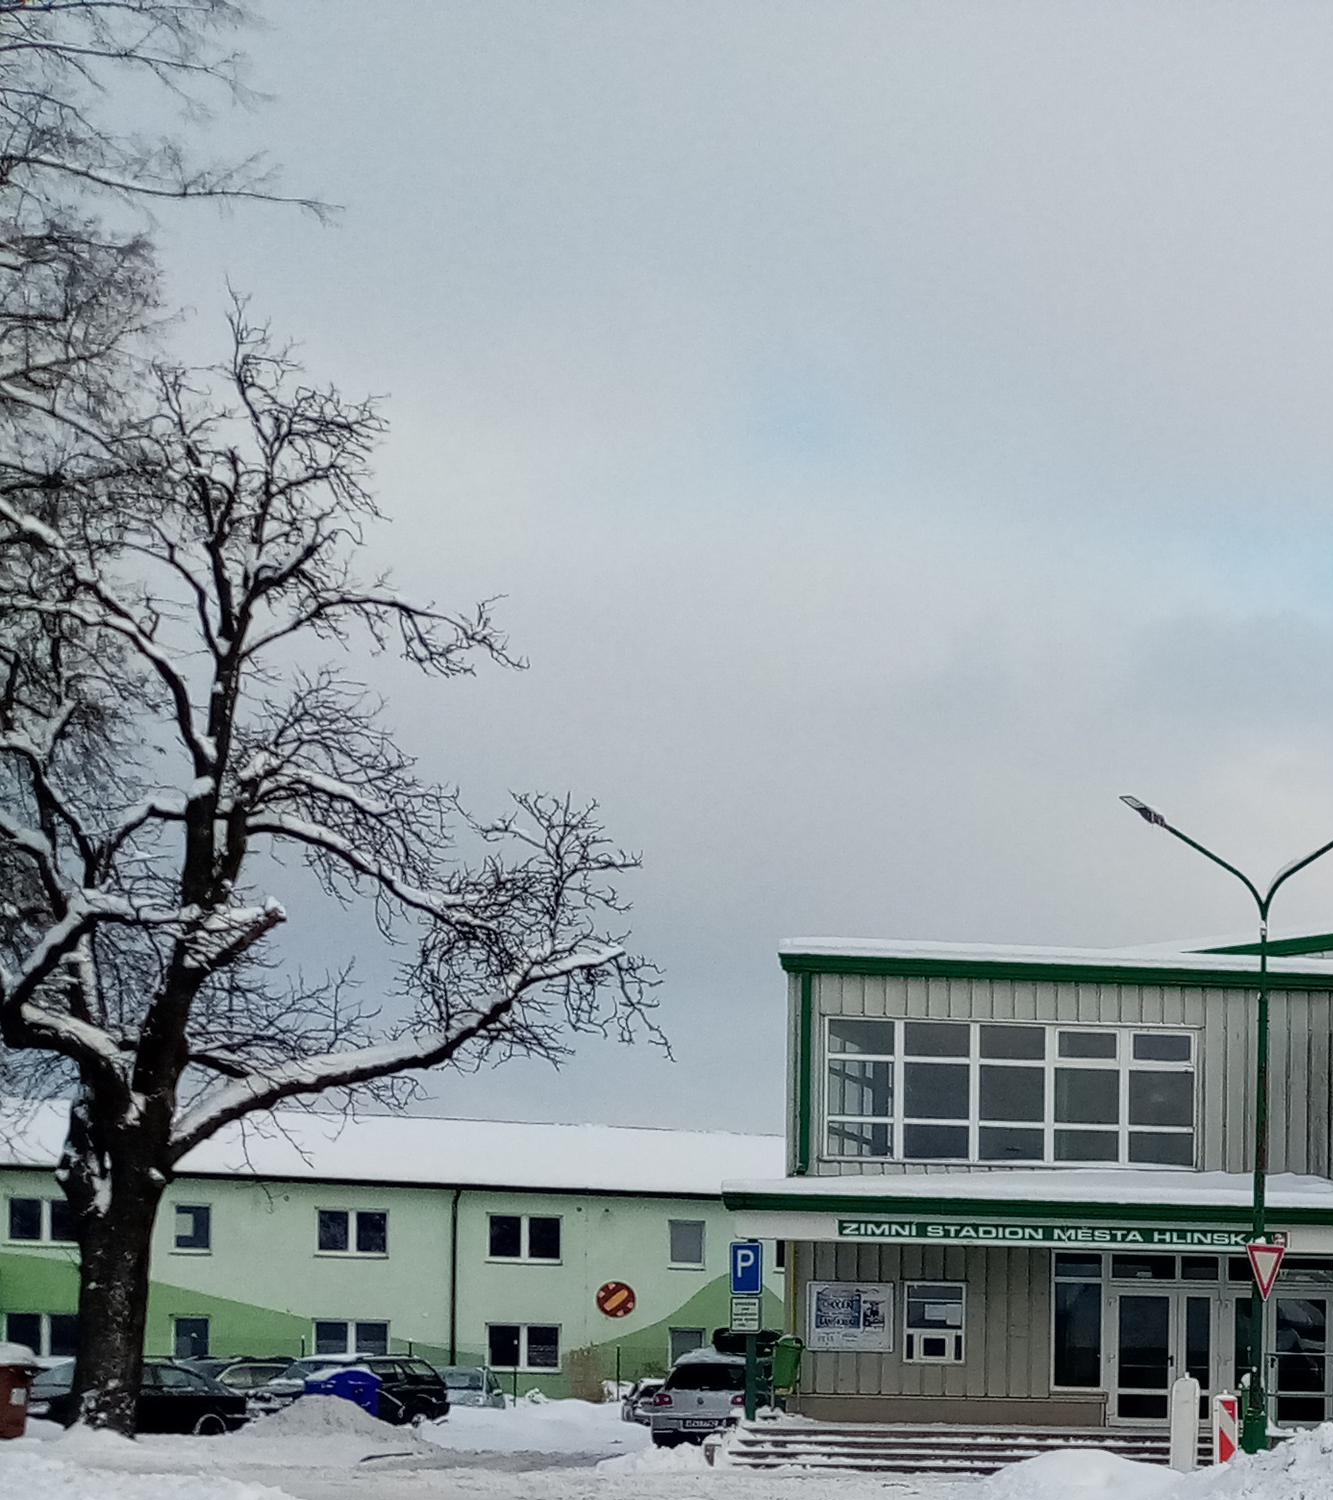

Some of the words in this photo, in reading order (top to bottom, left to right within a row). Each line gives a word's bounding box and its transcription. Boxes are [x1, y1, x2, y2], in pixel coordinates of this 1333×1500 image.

[842, 1222, 917, 1237] ZIMNÍ
[926, 1225, 1044, 1240] STADION
[1053, 1226, 1144, 1243] MĚSTA
[1153, 1231, 1257, 1246] HLINSK
[737, 1249, 754, 1278] P
